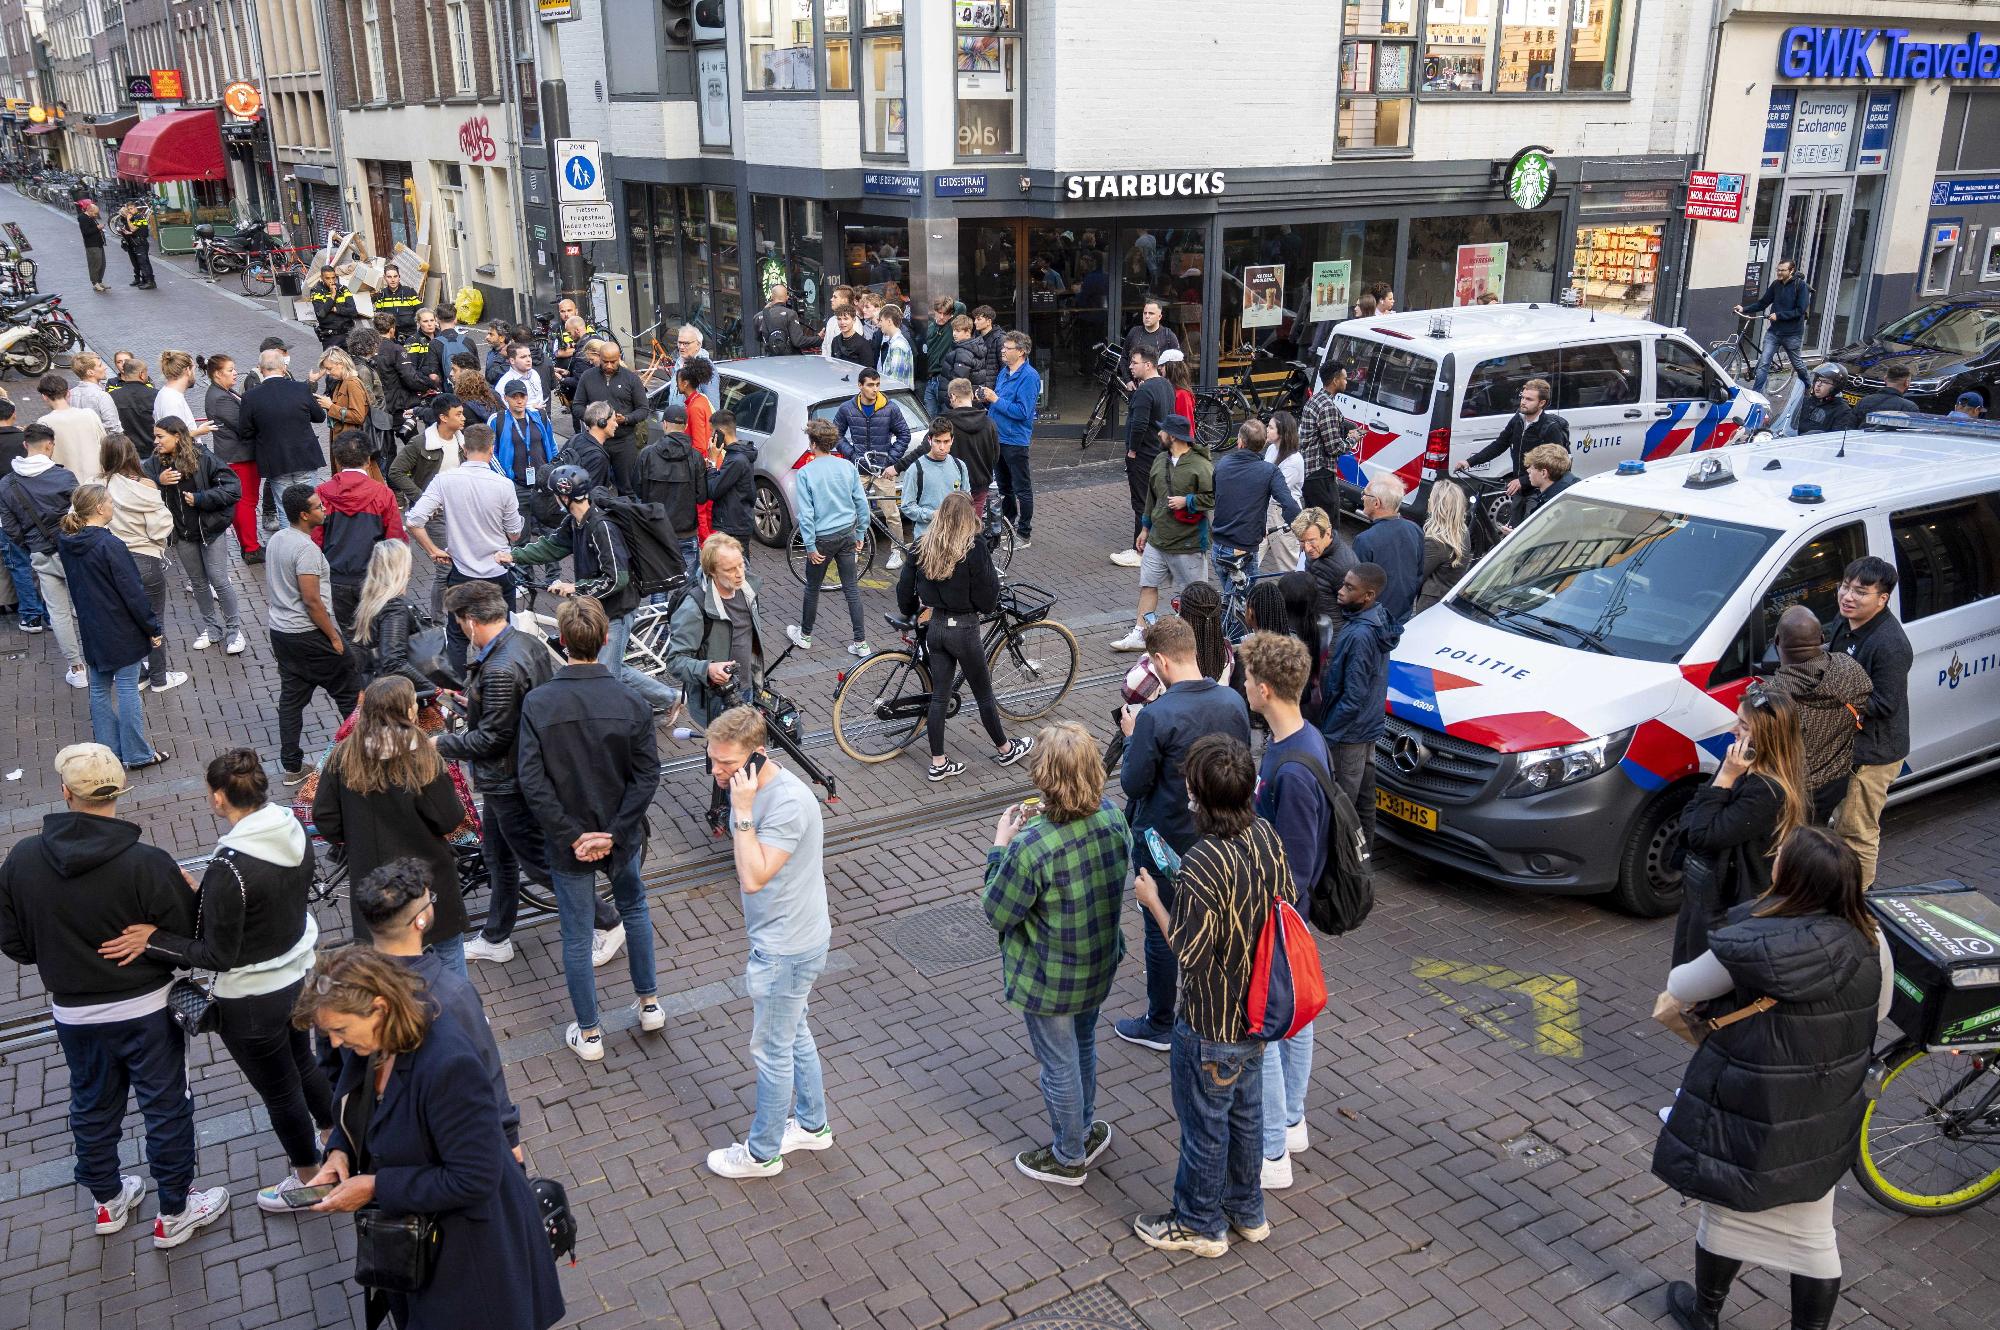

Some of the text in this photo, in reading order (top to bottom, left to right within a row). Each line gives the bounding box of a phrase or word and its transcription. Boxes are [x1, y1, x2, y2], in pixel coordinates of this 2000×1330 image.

[1781, 25, 1880, 78] GWK
[1800, 101, 1848, 117] Currency
[1871, 104, 1891, 112] GREAT
[1797, 118, 1847, 135] Exchange
[939, 176, 985, 187] LEIDSESTRAAT
[1067, 171, 1225, 199] STARBUCKS
[1692, 175, 1716, 186] TOBACCO
[1704, 192, 1737, 203] ACCESSORIES
[1687, 206, 1737, 219] INTERNET SIM CARD
[826, 275, 841, 286] 101
[1576, 435, 1622, 453] POLITIE
[1434, 646, 1531, 681] POLITIE
[1938, 654, 2000, 689] POLITI
[1412, 699, 1434, 712] 0309
[1973, 1007, 2000, 1026] POW
